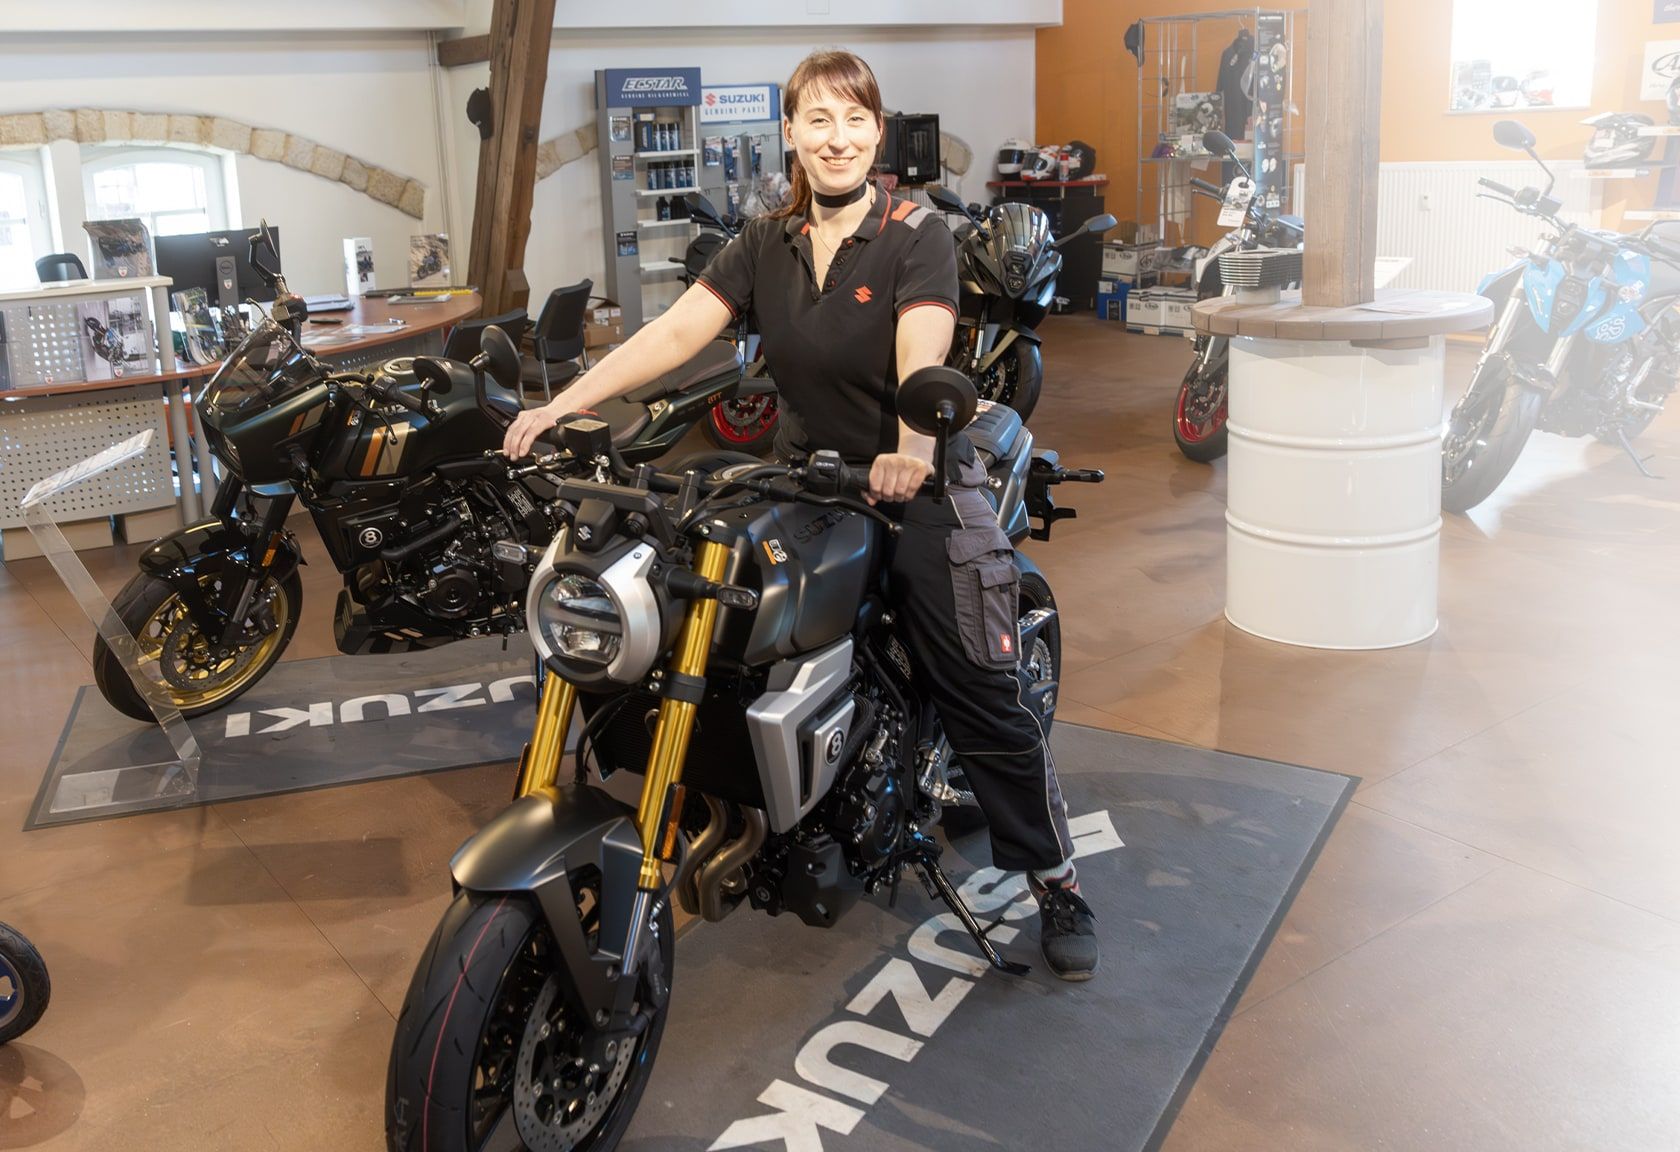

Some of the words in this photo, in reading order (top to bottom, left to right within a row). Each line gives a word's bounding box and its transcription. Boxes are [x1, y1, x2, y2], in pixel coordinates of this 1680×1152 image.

[622, 76, 688, 91] ECSTAR
[719, 93, 765, 104] SUZUKI
[704, 107, 737, 115] GENUINE
[364, 531, 377, 543] 8
[225, 675, 536, 738] UZUKI
[831, 733, 842, 756] 8
[706, 866, 1039, 1152] SUZUK
